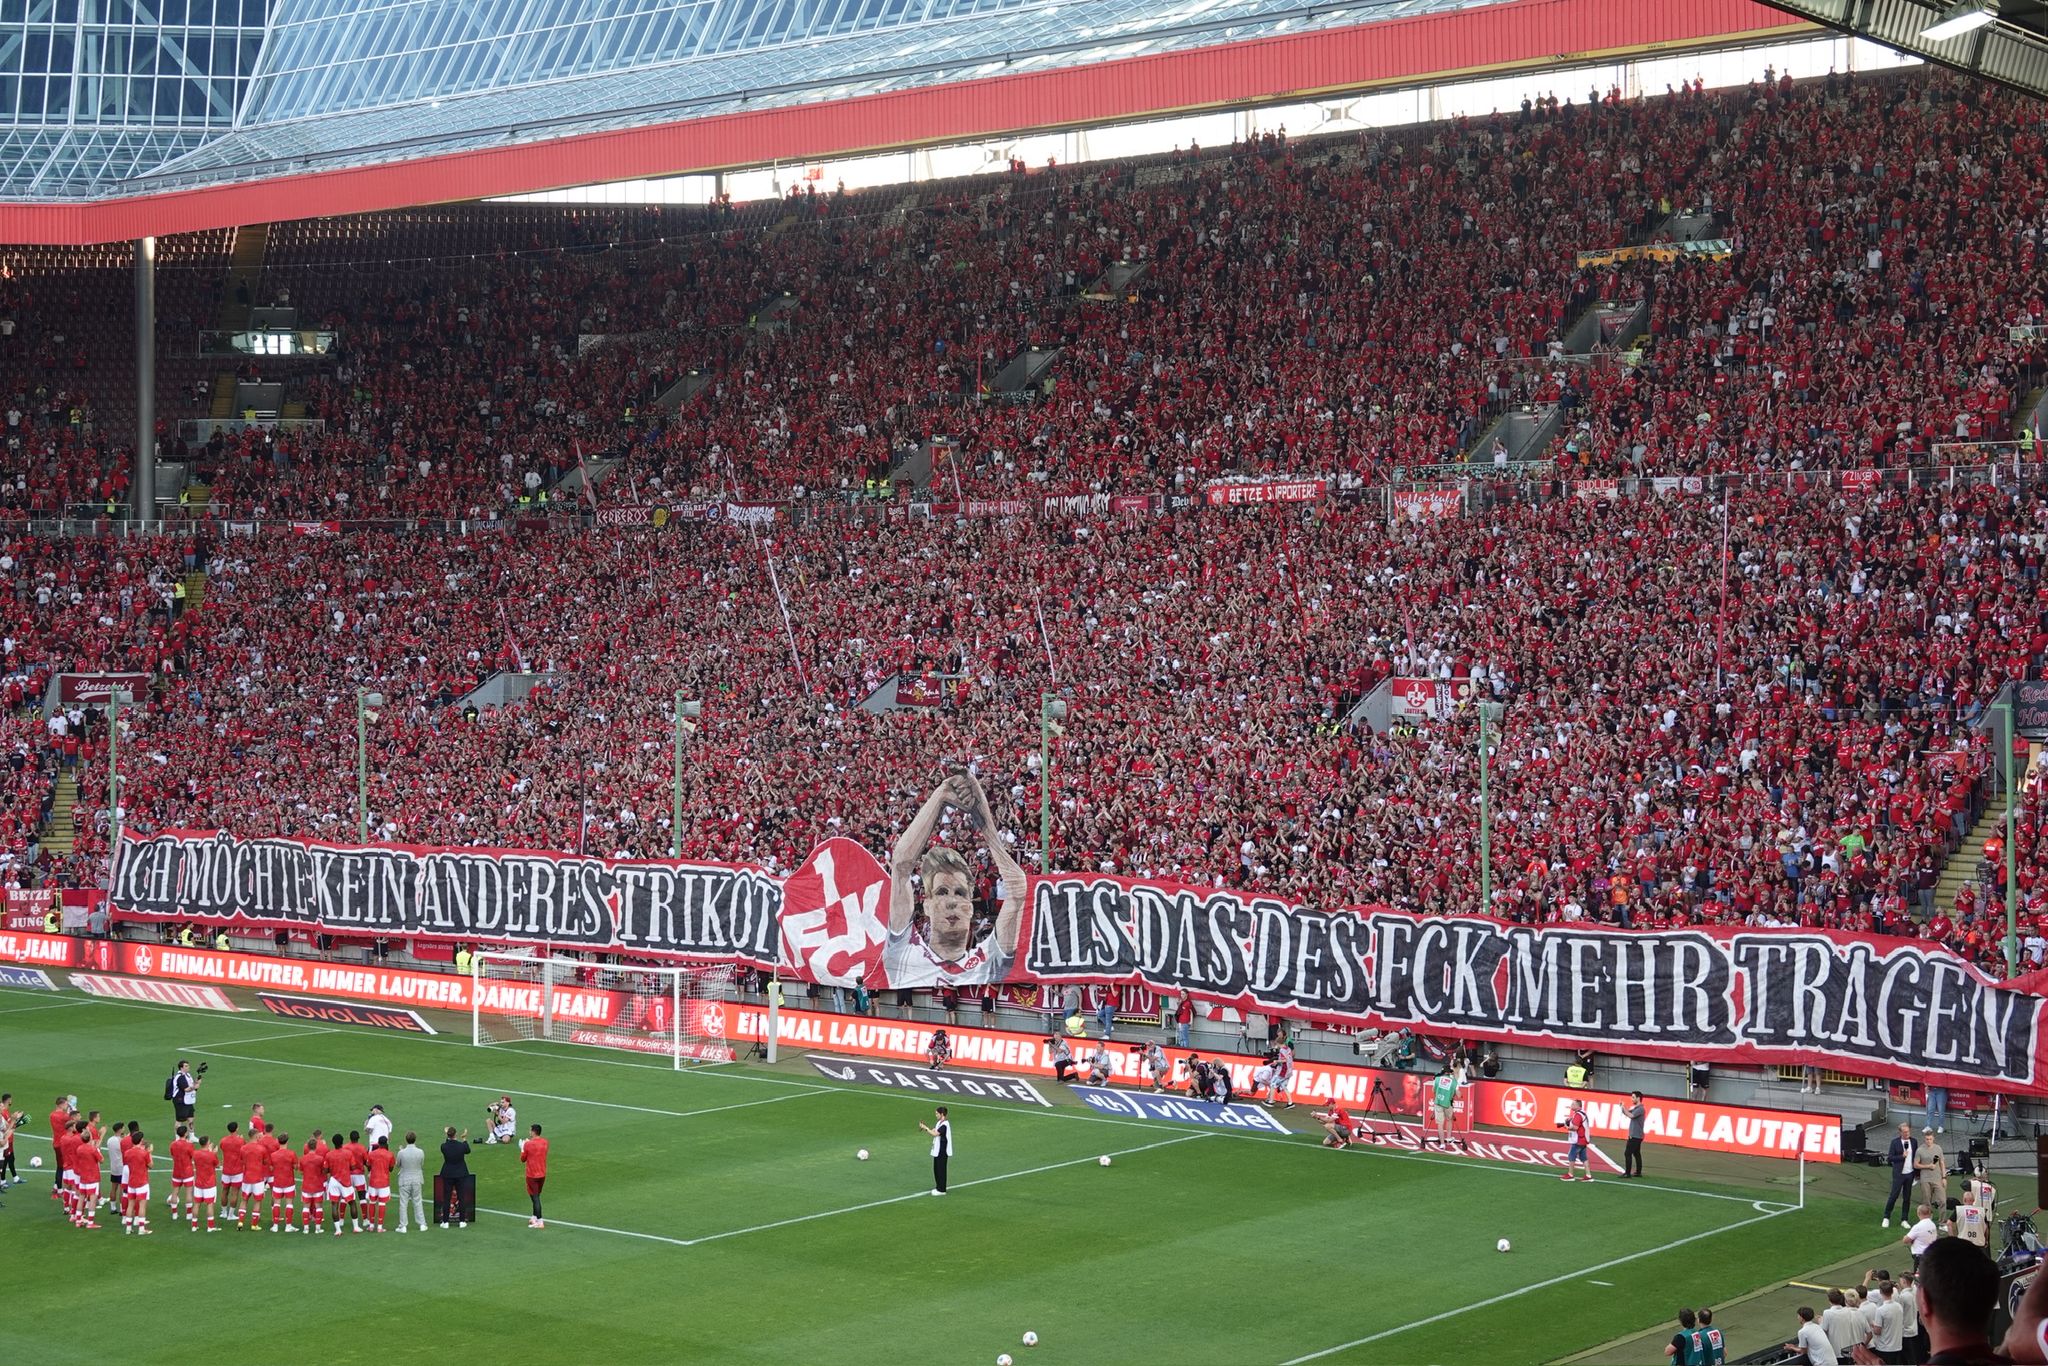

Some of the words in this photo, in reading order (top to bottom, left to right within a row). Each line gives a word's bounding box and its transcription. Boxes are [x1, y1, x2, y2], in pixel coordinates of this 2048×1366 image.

[1228, 486, 1263, 503] BETZE
[596, 508, 648, 525] KERBEROS
[9, 889, 51, 901] BETZE
[112, 840, 176, 902] ICH
[182, 833, 309, 914] MÖCHTE
[312, 849, 407, 925] KEIN
[422, 859, 602, 936] ANDERES
[616, 867, 779, 952] TRIKOT
[24, 938, 68, 961] JEAN!
[161, 953, 224, 980] EINMAL
[228, 960, 308, 990] LAUTRER,
[312, 968, 373, 992] IMMER
[379, 976, 468, 1005] LAUTRER.
[550, 992, 609, 1019] JEAN!
[1034, 884, 1119, 968] ALS
[1134, 891, 1237, 986] DAS
[1252, 907, 1356, 1003] DES
[1376, 920, 1493, 1019] FCK
[1508, 933, 1716, 1033] MEHR
[1737, 942, 2016, 1067] TRAGEN
[737, 1011, 824, 1042] EINMAL
[949, 1034, 1036, 1067] IMMER
[868, 1069, 1036, 1101] CASTORE
[1147, 1101, 1273, 1128] vlh.de
